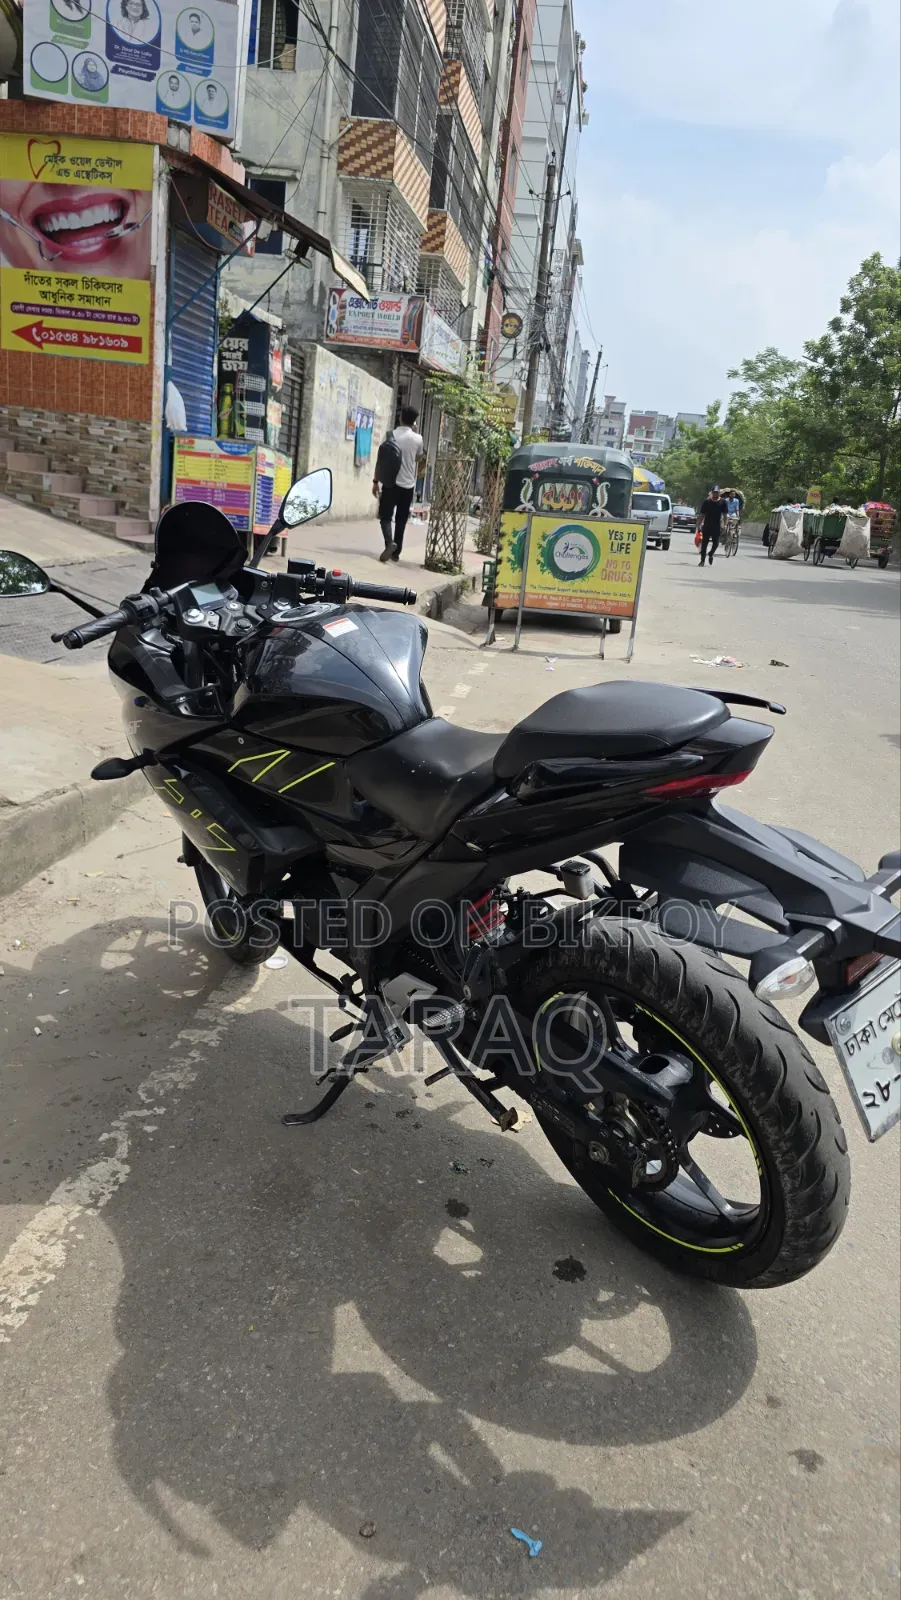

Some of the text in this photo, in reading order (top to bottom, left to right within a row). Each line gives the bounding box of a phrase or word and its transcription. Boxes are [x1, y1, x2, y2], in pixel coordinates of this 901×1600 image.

[95, 156, 123, 169] ডেন্টাল
[209, 204, 228, 233] TEA
[23, 271, 123, 294] দাঁতের সকল চিকিৎসার
[39, 288, 112, 308] আধুনিক সমাধান
[377, 312, 401, 321] WORLD
[219, 337, 249, 351] য়ের
[608, 529, 637, 542] YES TO
[610, 541, 631, 555] LIFE
[605, 558, 631, 571] NO TO
[600, 568, 633, 583] DRUGS
[844, 1020, 877, 1056] ঢাকা
